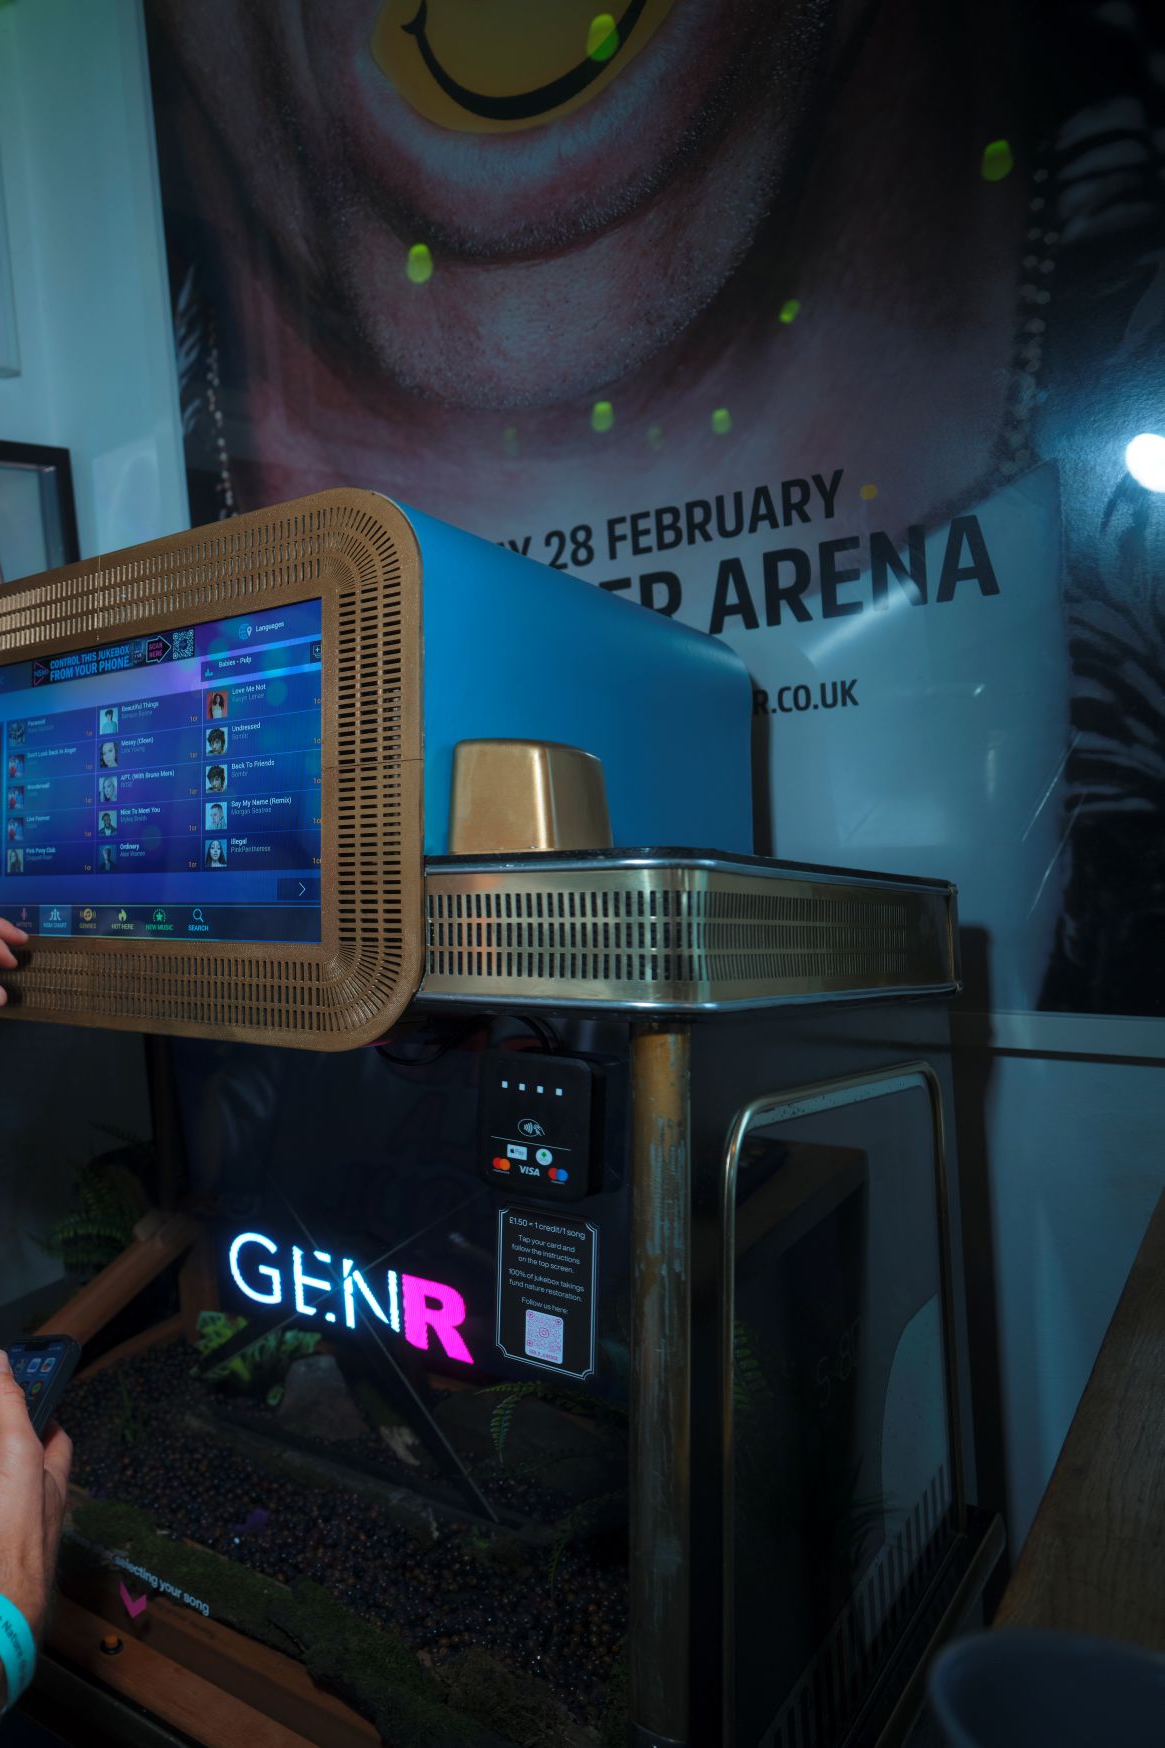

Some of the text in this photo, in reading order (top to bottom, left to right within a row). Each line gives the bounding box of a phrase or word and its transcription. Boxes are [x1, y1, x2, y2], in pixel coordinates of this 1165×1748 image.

[544, 469, 844, 571] 28 FEBRUARY
[707, 514, 1001, 635] ARENA
[255, 621, 285, 633] Languages
[149, 641, 163, 650] SCAN
[50, 646, 130, 669] CONTROL THIS JUKEBOX
[219, 659, 235, 668] Babies
[240, 656, 252, 666] Pulp
[50, 656, 130, 682] FROM YOUR PHONE
[232, 687, 246, 695] Love
[255, 683, 267, 691] Not
[121, 701, 159, 712] Beautiful Things
[231, 722, 261, 732] Undressed
[254, 759, 275, 768] Friends
[231, 797, 292, 808] Say My Name (Remix)
[119, 843, 140, 851] Ordinary
[231, 837, 247, 846] Illegal
[518, 1164, 541, 1177] VISA
[509, 1216, 528, 1227] £1.50
[566, 1230, 586, 1241] song
[518, 1234, 576, 1253] Tap your card and
[511, 1243, 581, 1265] follow the instructions
[527, 1256, 538, 1265] the
[538, 1259, 550, 1269] top
[550, 1263, 575, 1274] screen.
[508, 1268, 585, 1293] 100% of jukebox takings
[509, 1278, 583, 1303] fund nature restoration.
[521, 1296, 569, 1315] Follow us here:
[114, 1555, 159, 1588] selecting
[159, 1577, 182, 1598] your
[183, 1592, 210, 1616] song
[2, 1620, 24, 1657] Nature
